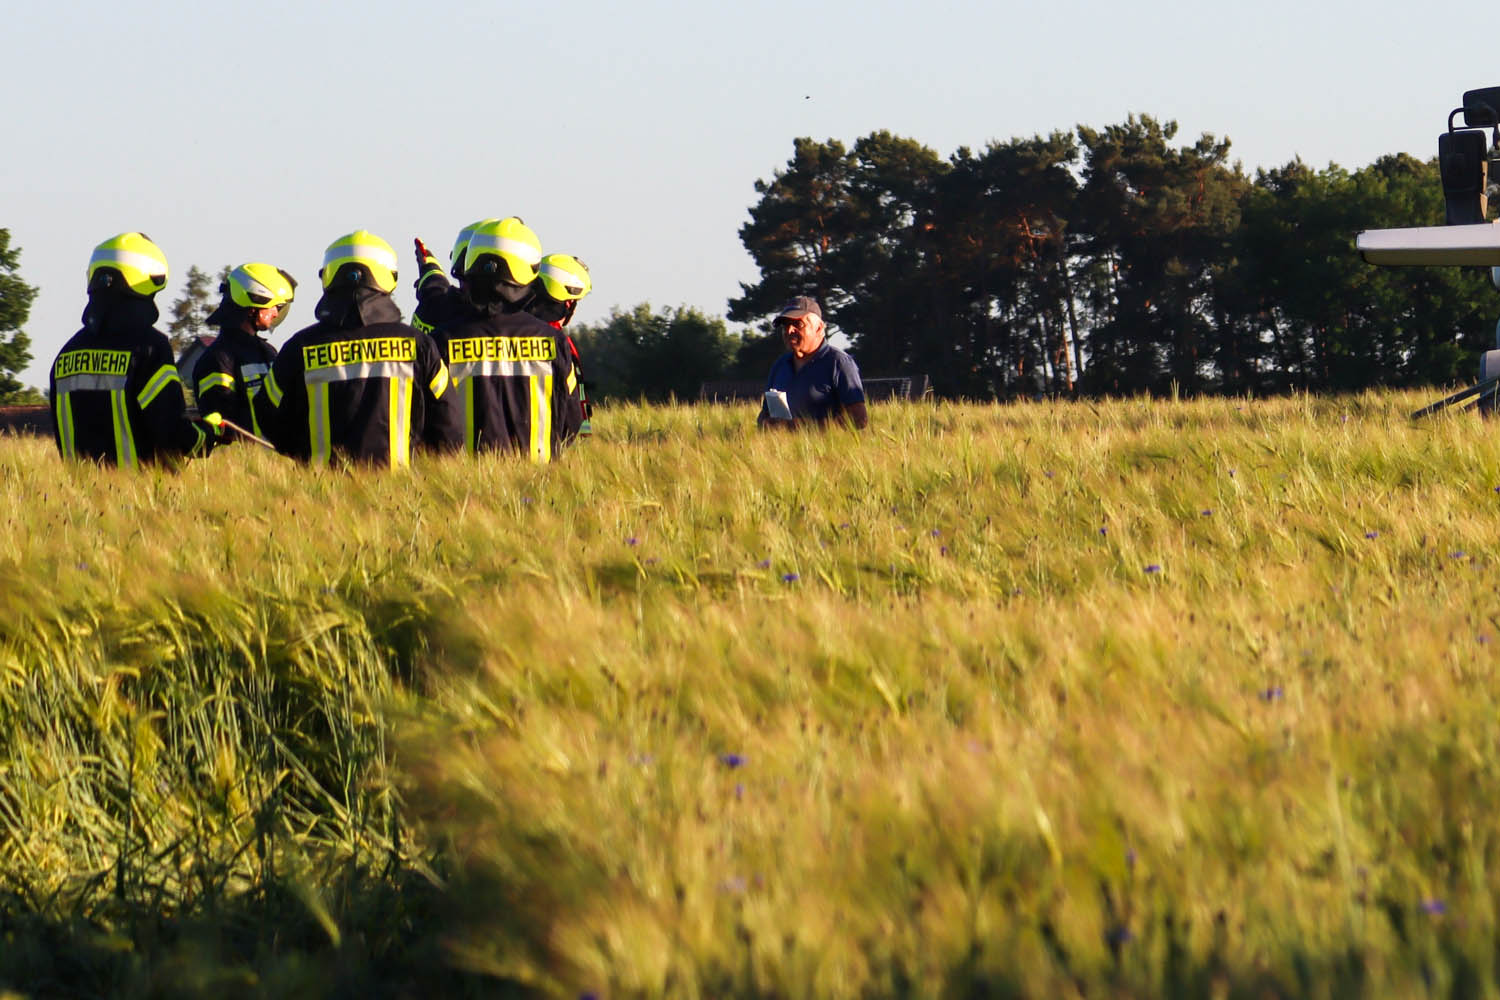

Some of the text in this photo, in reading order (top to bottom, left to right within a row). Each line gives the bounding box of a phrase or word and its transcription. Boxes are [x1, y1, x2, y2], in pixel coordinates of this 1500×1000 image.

[306, 340, 413, 368] FEUERWEHR
[452, 340, 553, 359] FEUERWEHR
[57, 351, 128, 375] FEUERWEHR
